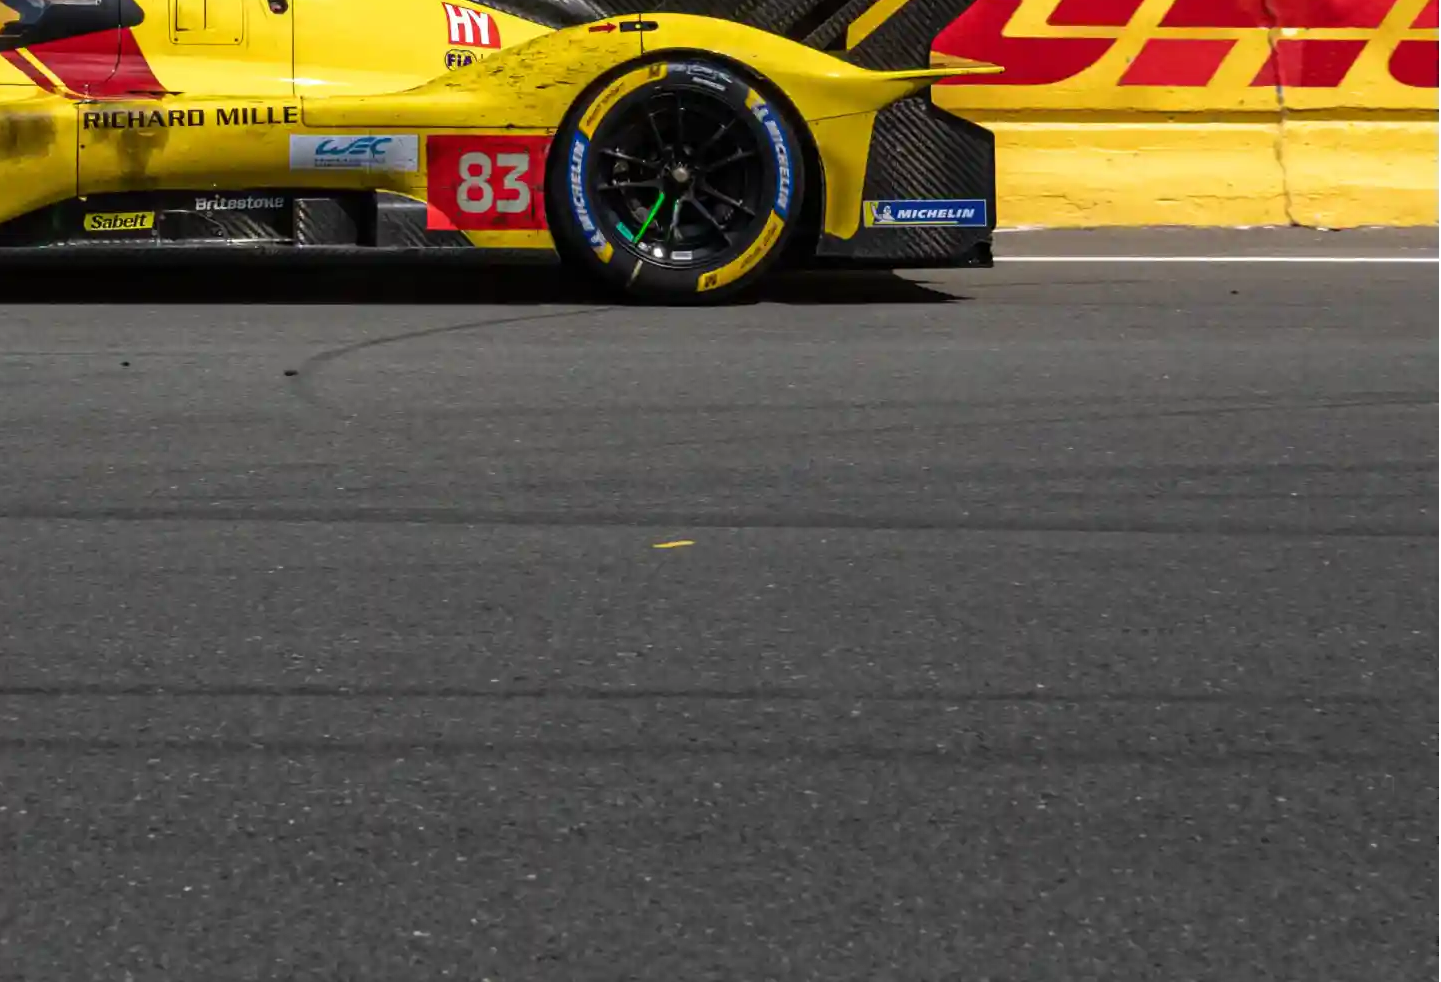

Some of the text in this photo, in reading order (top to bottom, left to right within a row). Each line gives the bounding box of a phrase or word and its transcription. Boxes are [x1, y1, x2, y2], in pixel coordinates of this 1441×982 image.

[445, 3, 491, 45] HY
[83, 105, 298, 130] RICHARD MILLE
[456, 151, 531, 214] 83
[570, 139, 596, 231] MICHELIN
[764, 119, 790, 211] MICHELIN
[90, 213, 148, 230] Sabelt
[897, 208, 975, 219] MICHELIN
